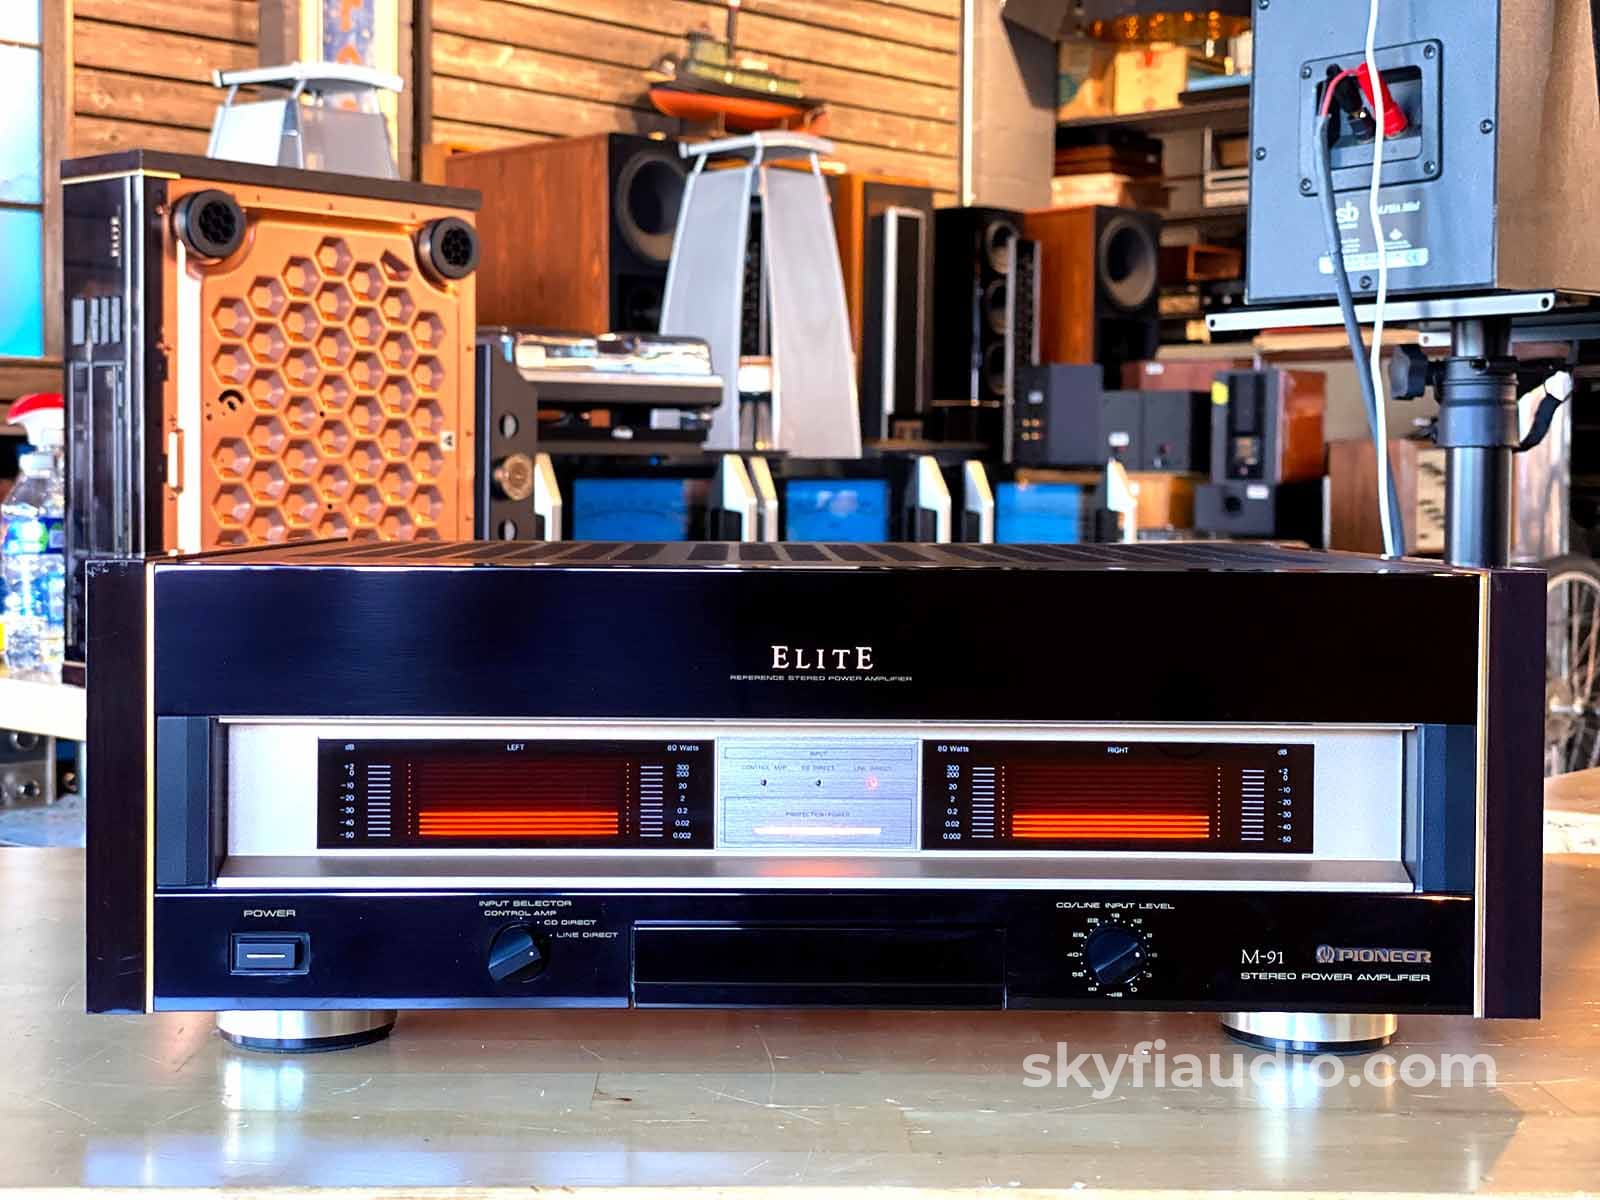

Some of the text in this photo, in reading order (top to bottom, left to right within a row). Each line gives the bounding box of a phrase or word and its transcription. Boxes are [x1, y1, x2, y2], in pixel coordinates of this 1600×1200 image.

[771, 645, 874, 670] ELITE
[828, 674, 862, 682] POWER
[507, 743, 525, 751] LEFT
[679, 744, 699, 752] Watts
[1107, 746, 1128, 754] RIGHT
[243, 909, 296, 917] POWER
[1241, 948, 1285, 965] M-91
[1335, 948, 1432, 964] PIONEER
[1240, 972, 1430, 982] STEREO POWER AMPLIFIER
